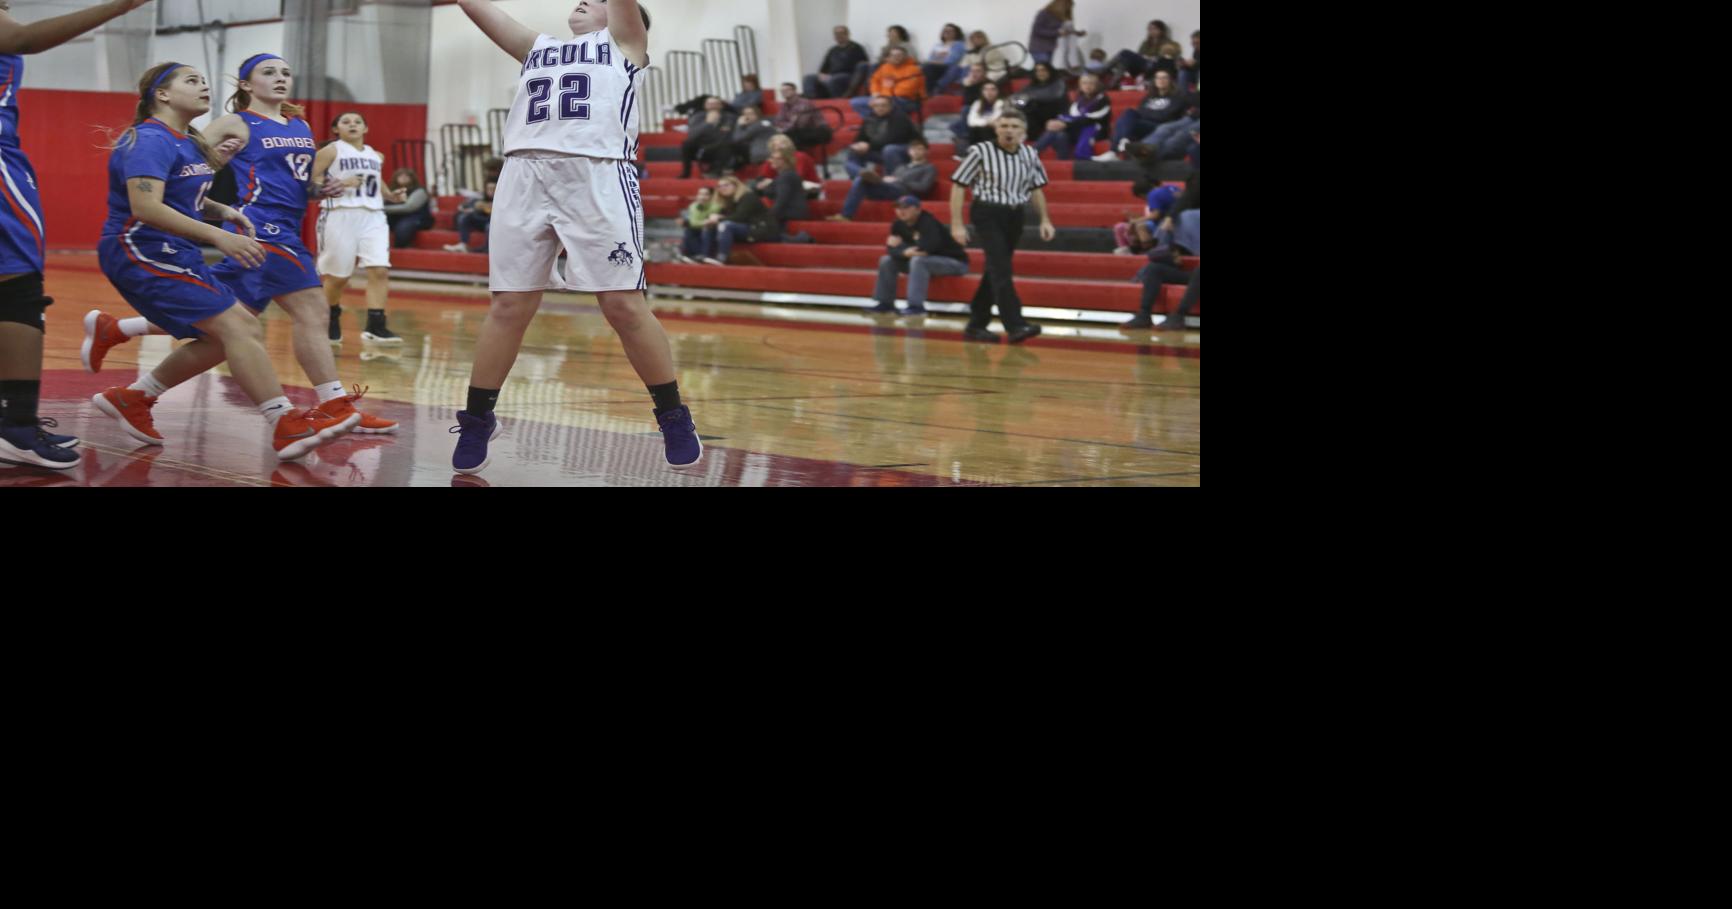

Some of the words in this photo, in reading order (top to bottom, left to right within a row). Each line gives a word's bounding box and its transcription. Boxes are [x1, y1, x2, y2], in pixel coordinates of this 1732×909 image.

[526, 73, 591, 125] 22
[262, 137, 315, 150] BOMBE
[285, 153, 312, 181] 12
